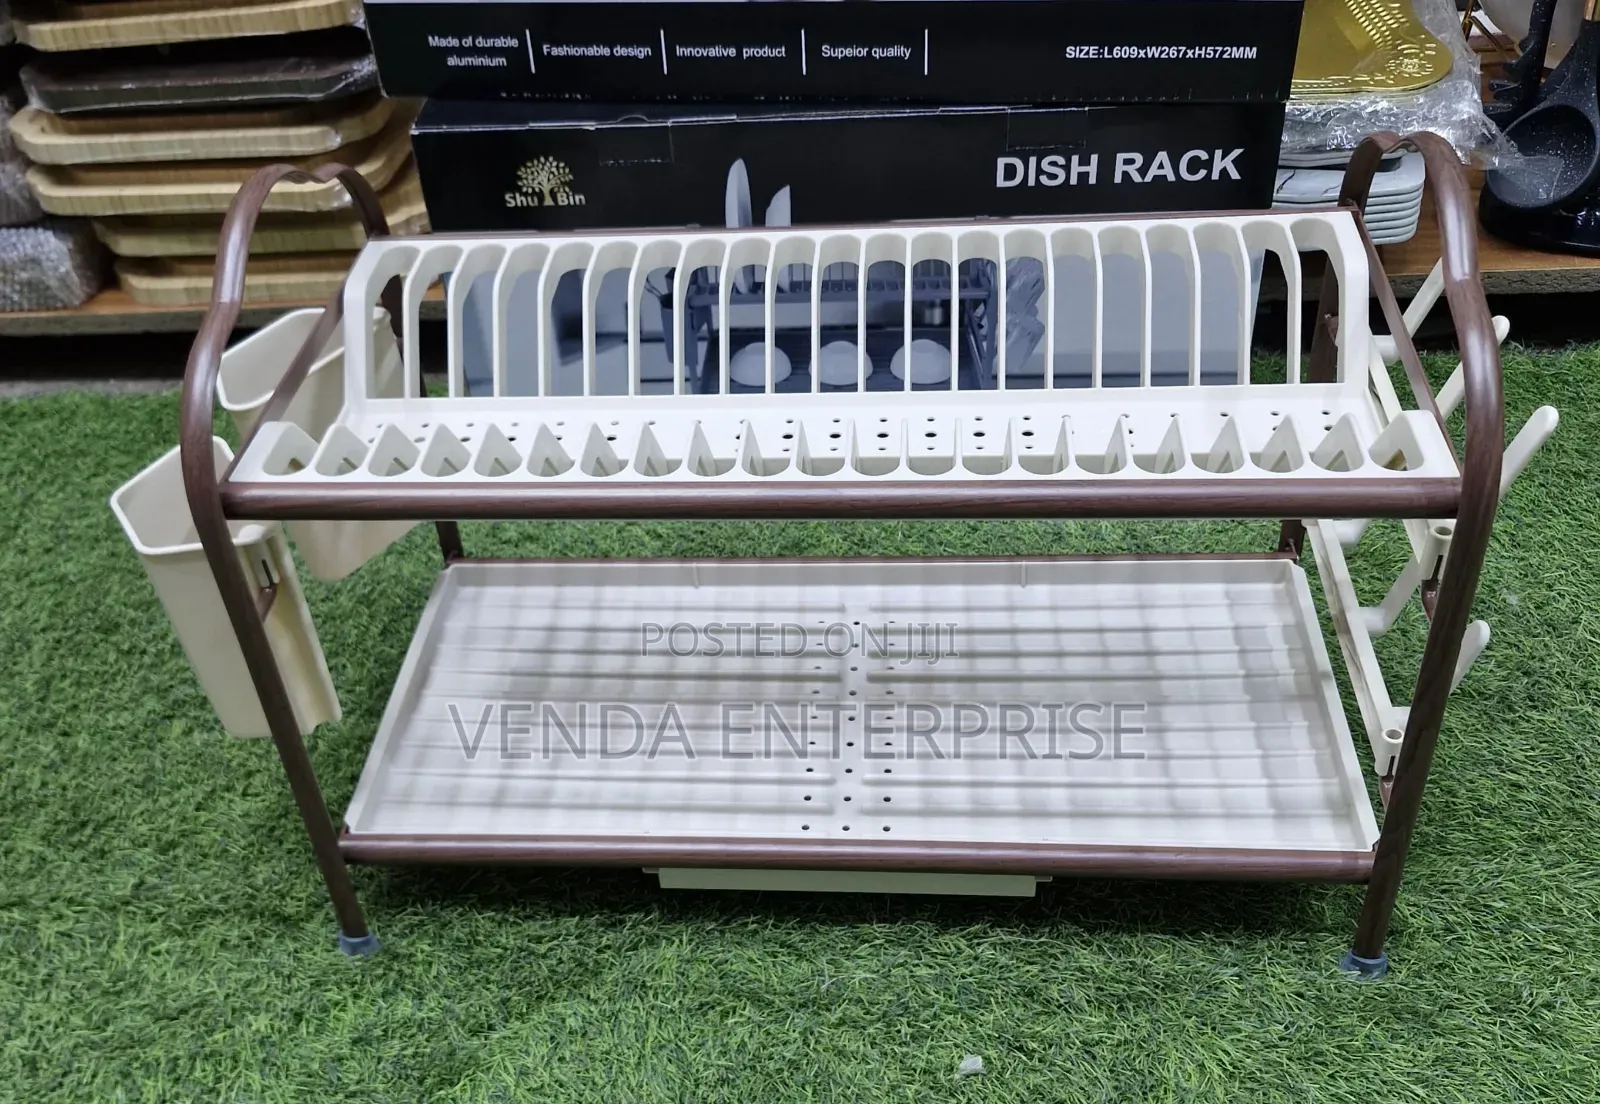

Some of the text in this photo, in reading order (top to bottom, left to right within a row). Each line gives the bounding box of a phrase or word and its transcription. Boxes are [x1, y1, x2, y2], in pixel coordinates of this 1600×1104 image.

[427, 35, 519, 48] Made of durable
[542, 44, 652, 59] Fashionable design
[675, 44, 786, 60] Innovative product
[821, 44, 912, 60] Supeior quality
[1065, 45, 1258, 59] SIZE:L609xW267xH572MM
[447, 55, 507, 67] aluminium
[995, 148, 1246, 188] DISH RACK
[504, 191, 586, 207] Shu Bin
